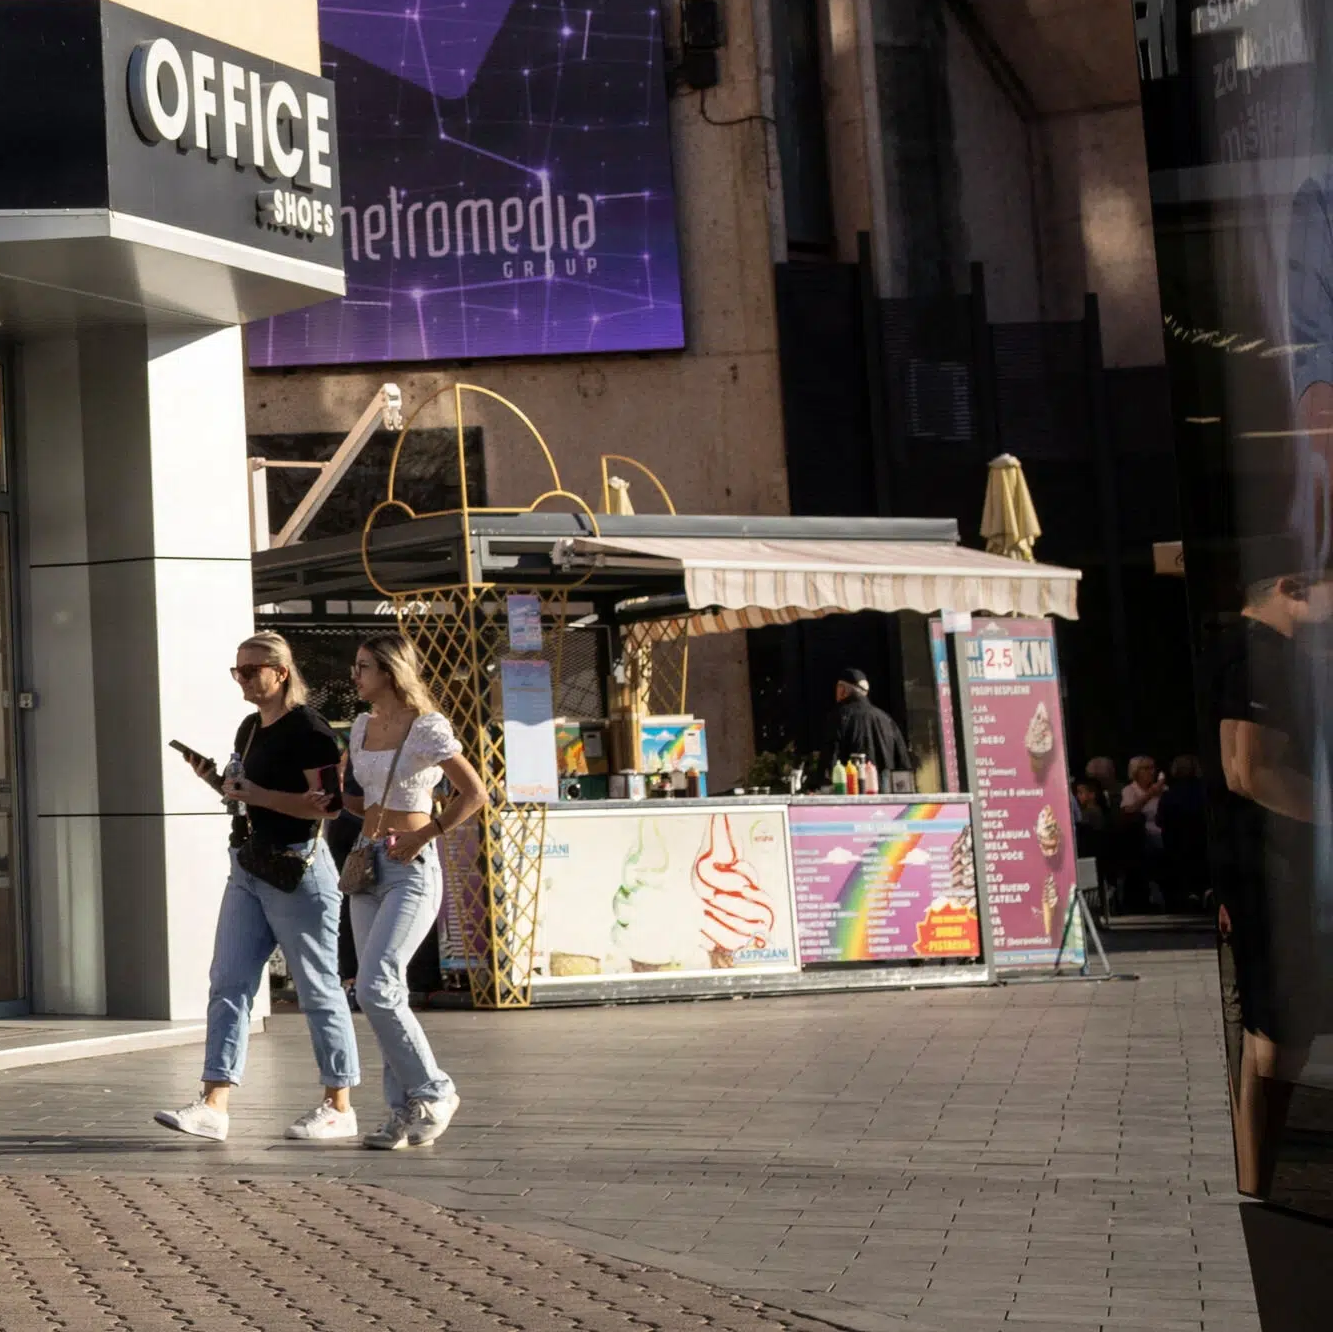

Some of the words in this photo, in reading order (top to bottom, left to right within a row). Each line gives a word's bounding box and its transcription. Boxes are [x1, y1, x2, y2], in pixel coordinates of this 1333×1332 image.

[144, 37, 332, 189] OFFICE
[273, 189, 334, 238] SHOES
[502, 257, 598, 279] GROUP
[985, 647, 1013, 669] 2,5
[1013, 640, 1052, 677] KM
